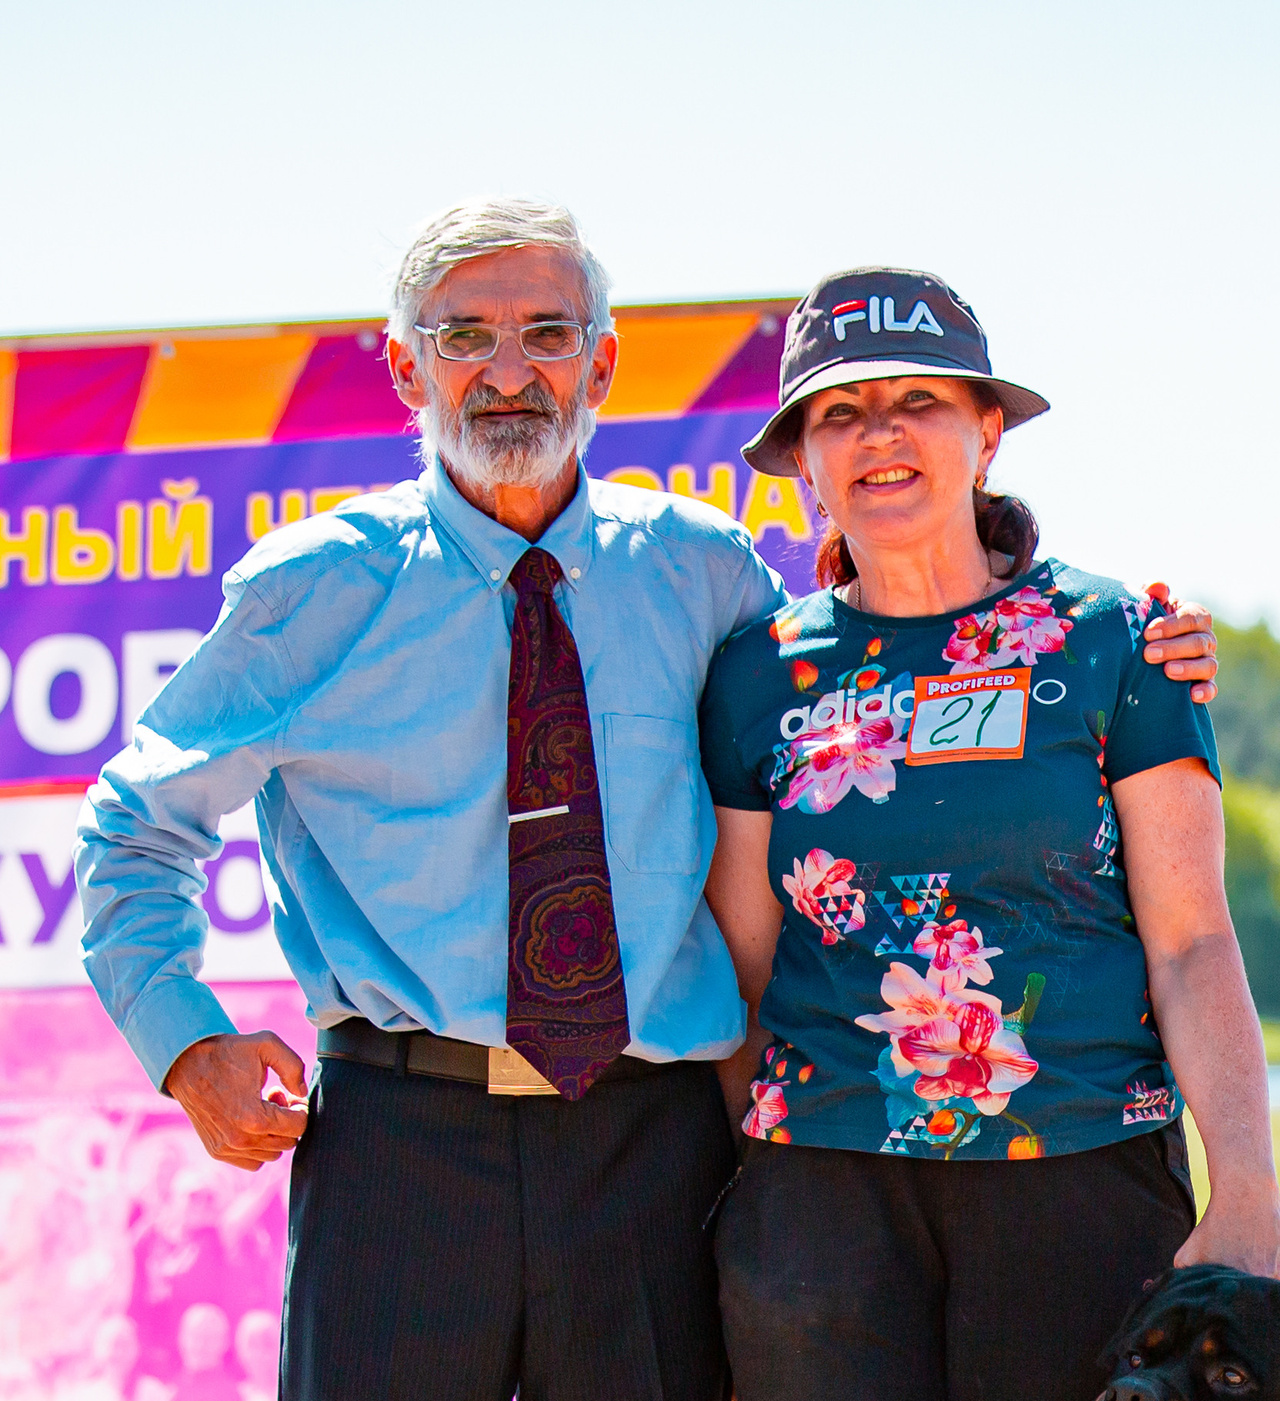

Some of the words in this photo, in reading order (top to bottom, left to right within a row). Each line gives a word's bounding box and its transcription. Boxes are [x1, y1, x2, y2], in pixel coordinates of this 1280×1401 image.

[831, 295, 945, 342] FILA
[779, 674, 916, 741] adida
[927, 674, 1017, 696] PROFIFEED
[929, 689, 1002, 747] 21
